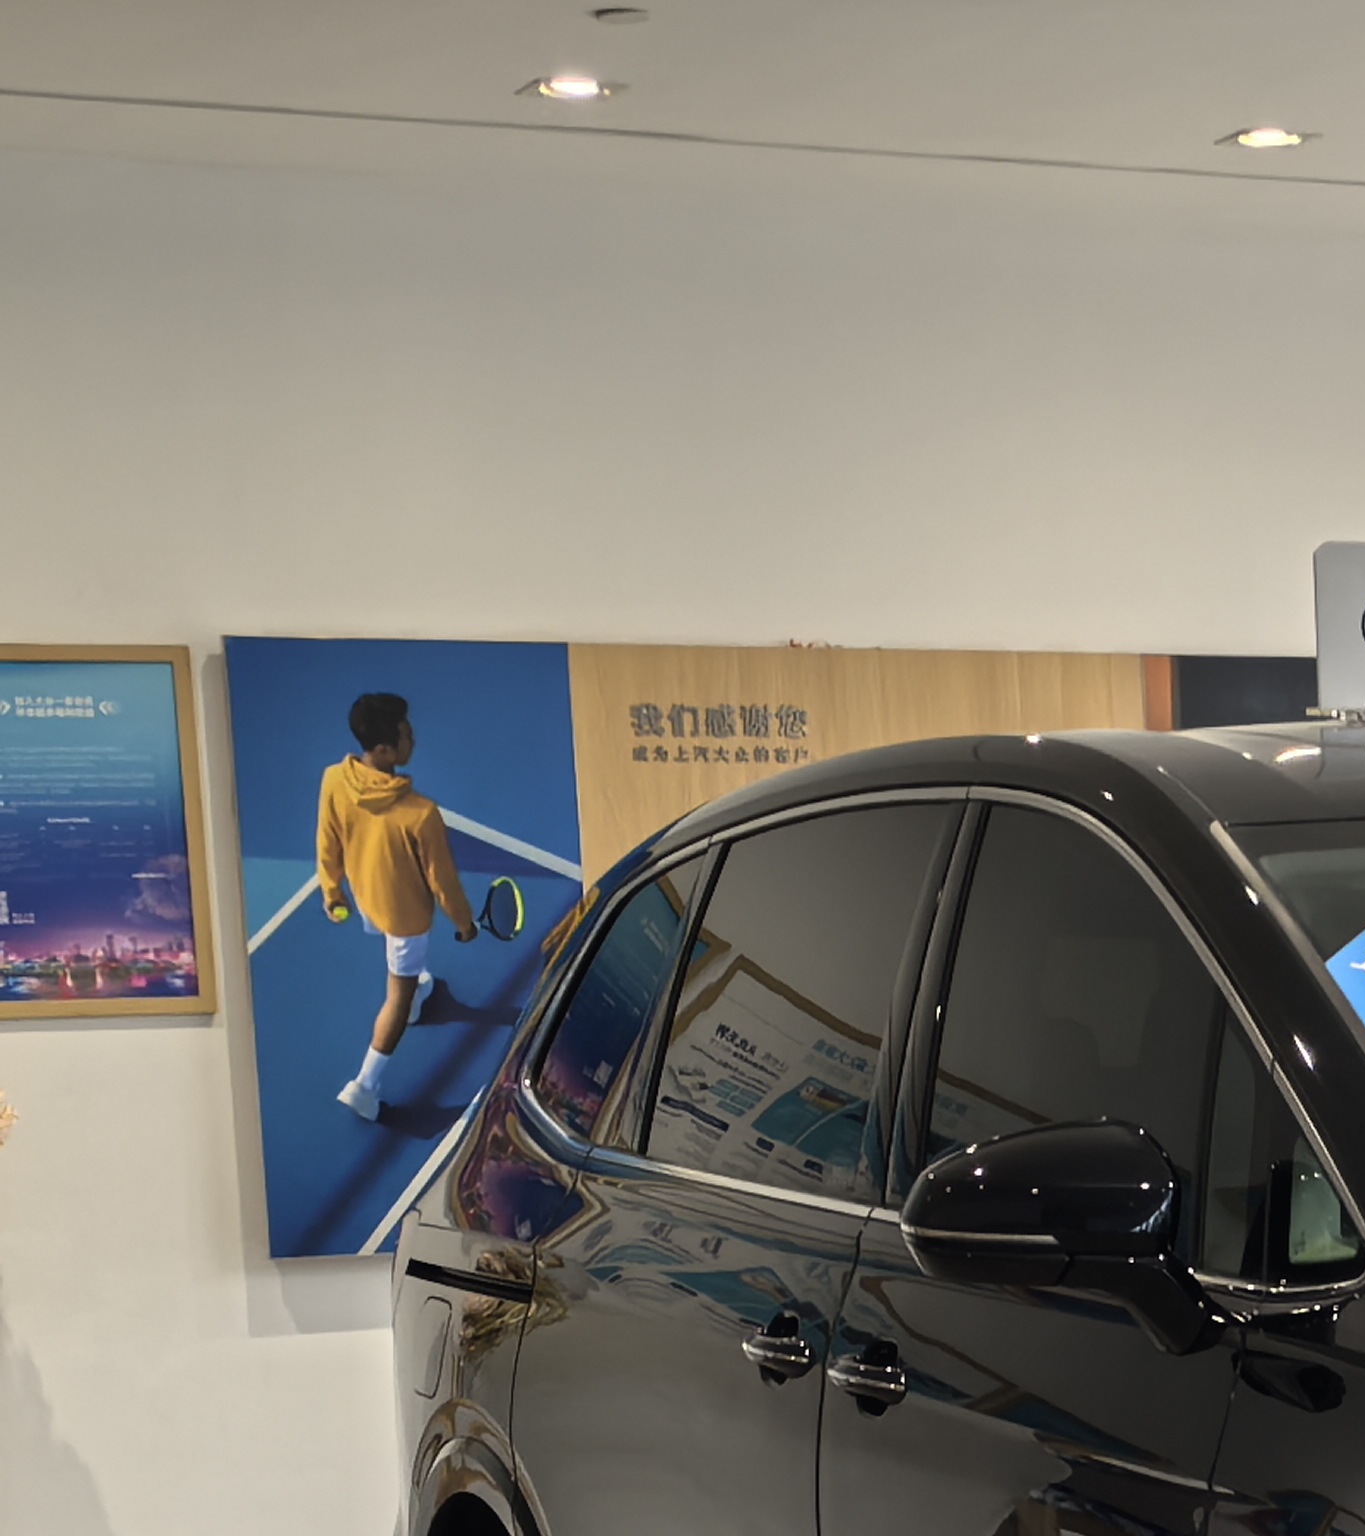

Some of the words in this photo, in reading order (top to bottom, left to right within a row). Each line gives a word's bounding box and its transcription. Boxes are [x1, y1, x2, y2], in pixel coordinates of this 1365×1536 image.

[629, 703, 808, 738] 我们感谢您
[632, 745, 809, 764] 成为上汽大众的客户
